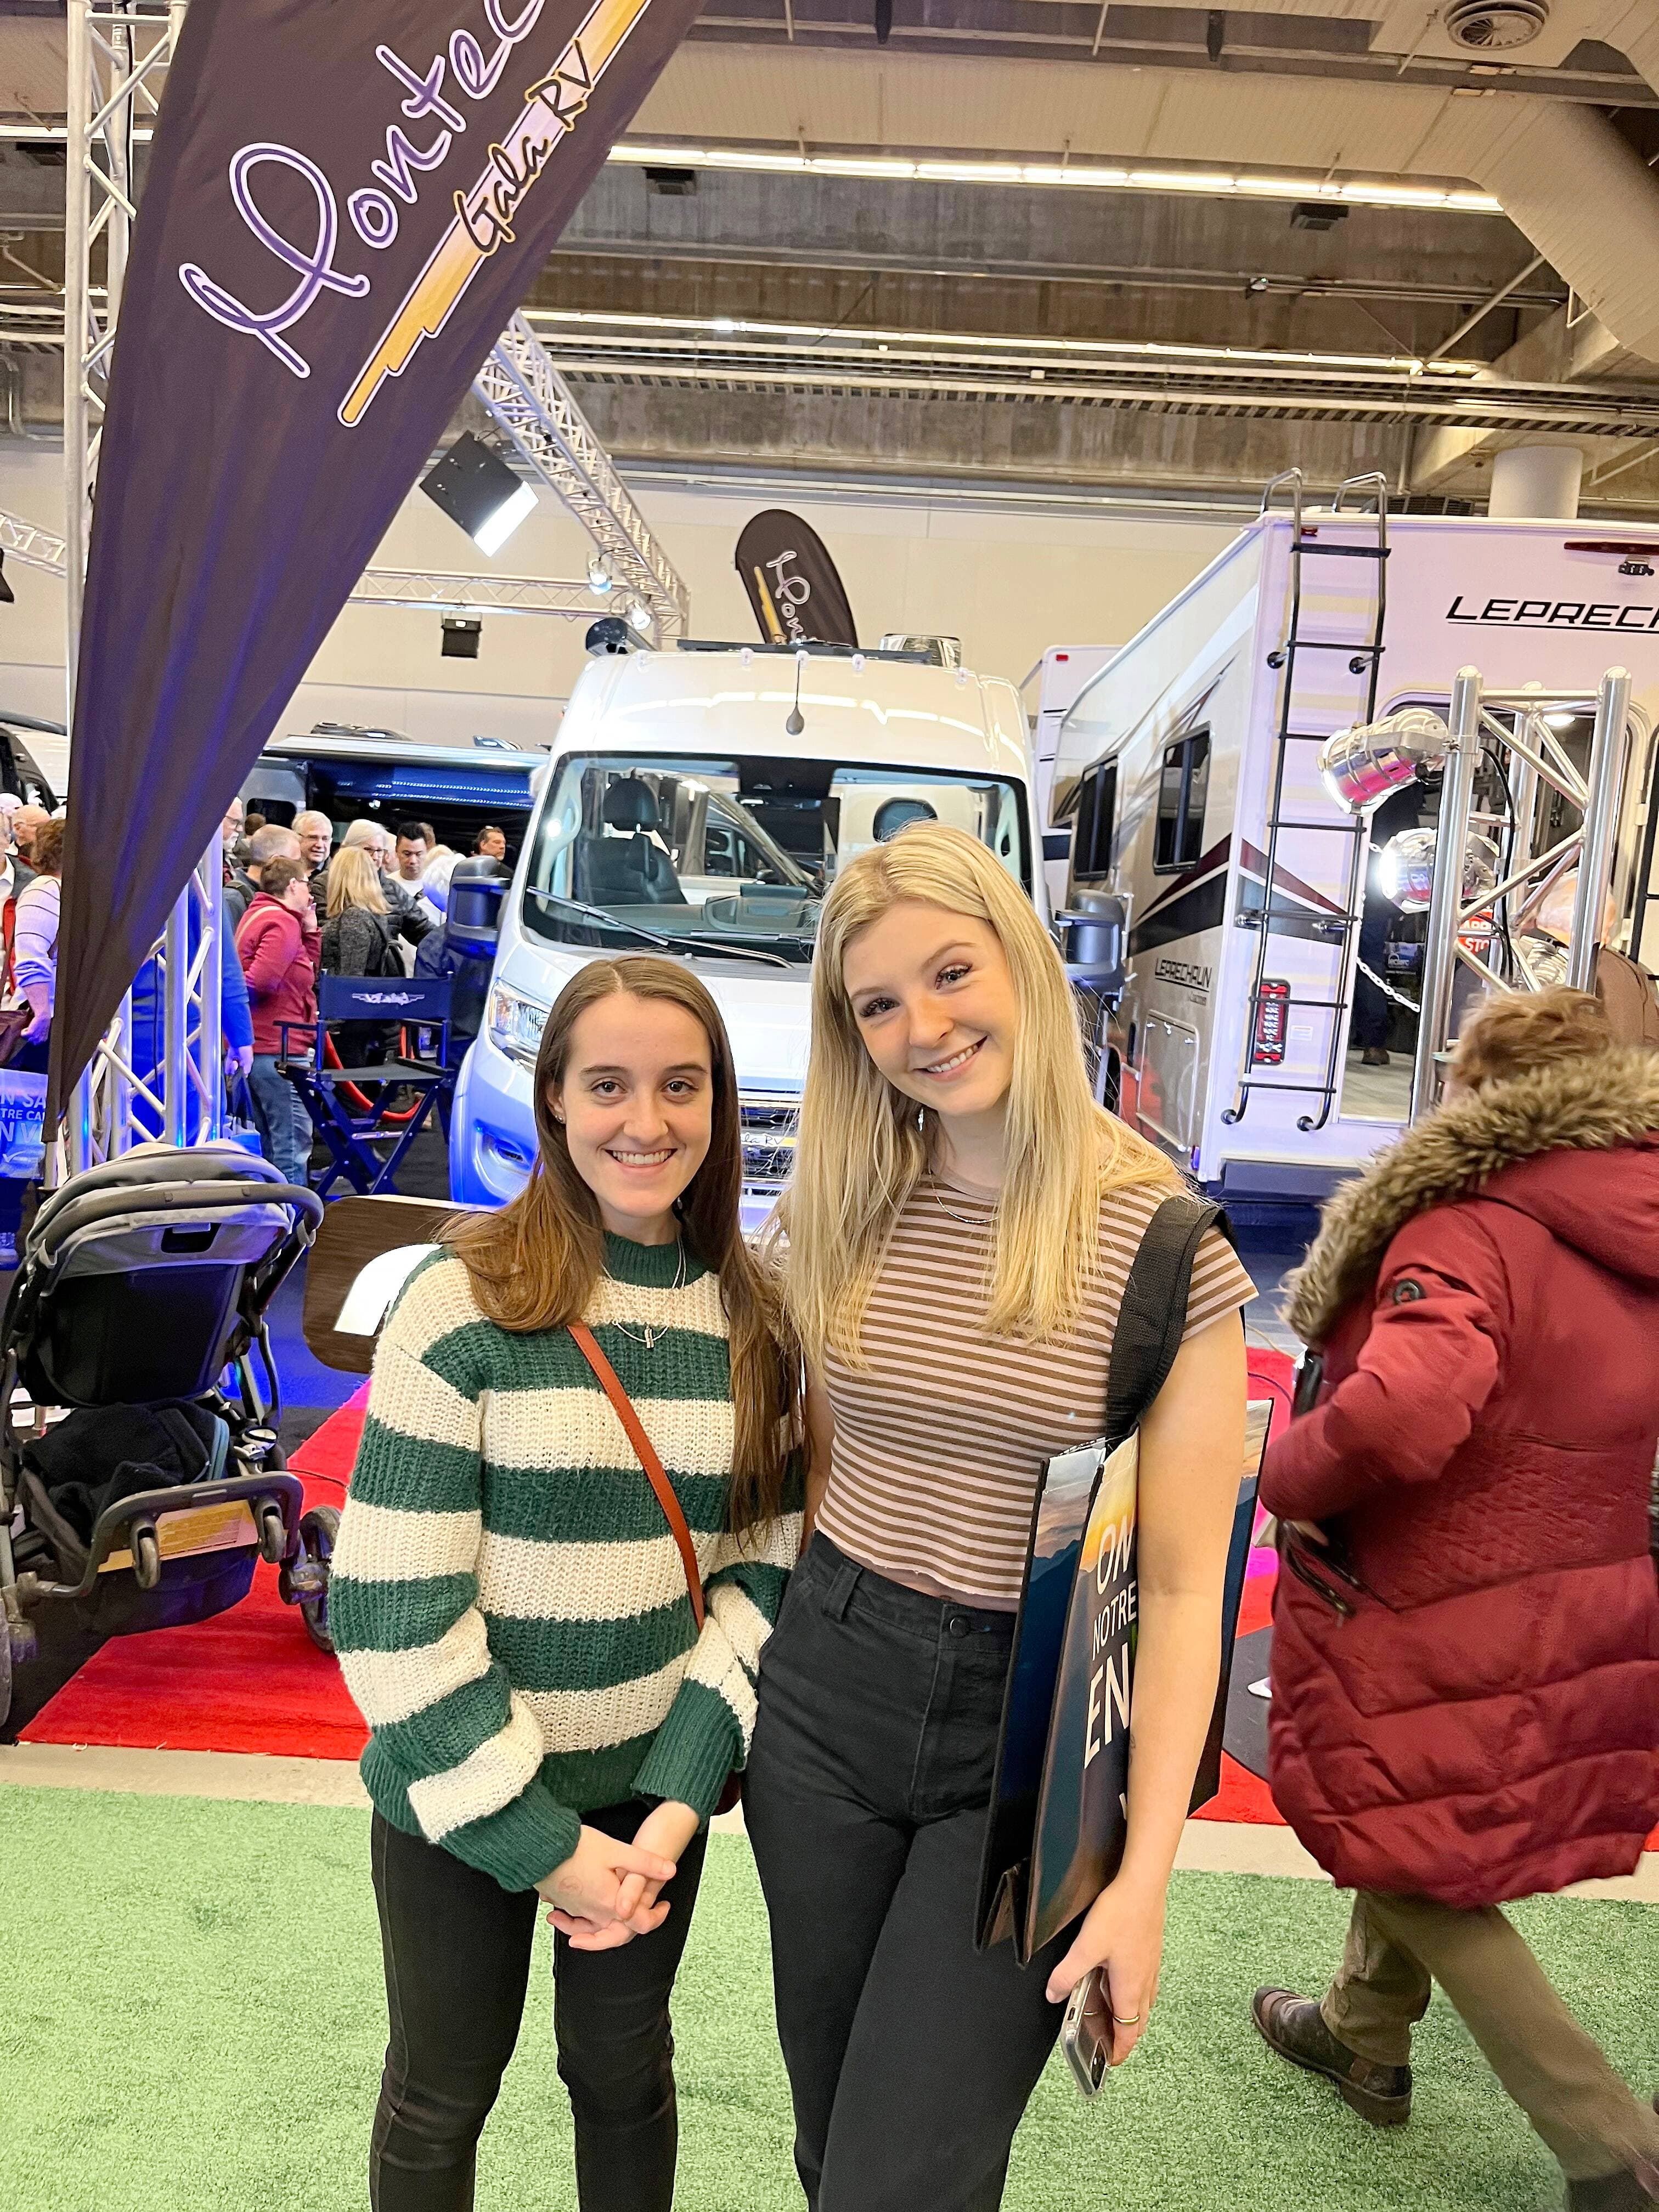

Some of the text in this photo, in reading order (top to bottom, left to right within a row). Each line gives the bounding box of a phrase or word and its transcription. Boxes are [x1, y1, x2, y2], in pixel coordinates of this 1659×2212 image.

[454, 39, 595, 257] Gala RV
[1097, 1509, 1135, 1595] ON
[1092, 1580, 1136, 1661] NOTRE
[1084, 1642, 1130, 1769] EN
